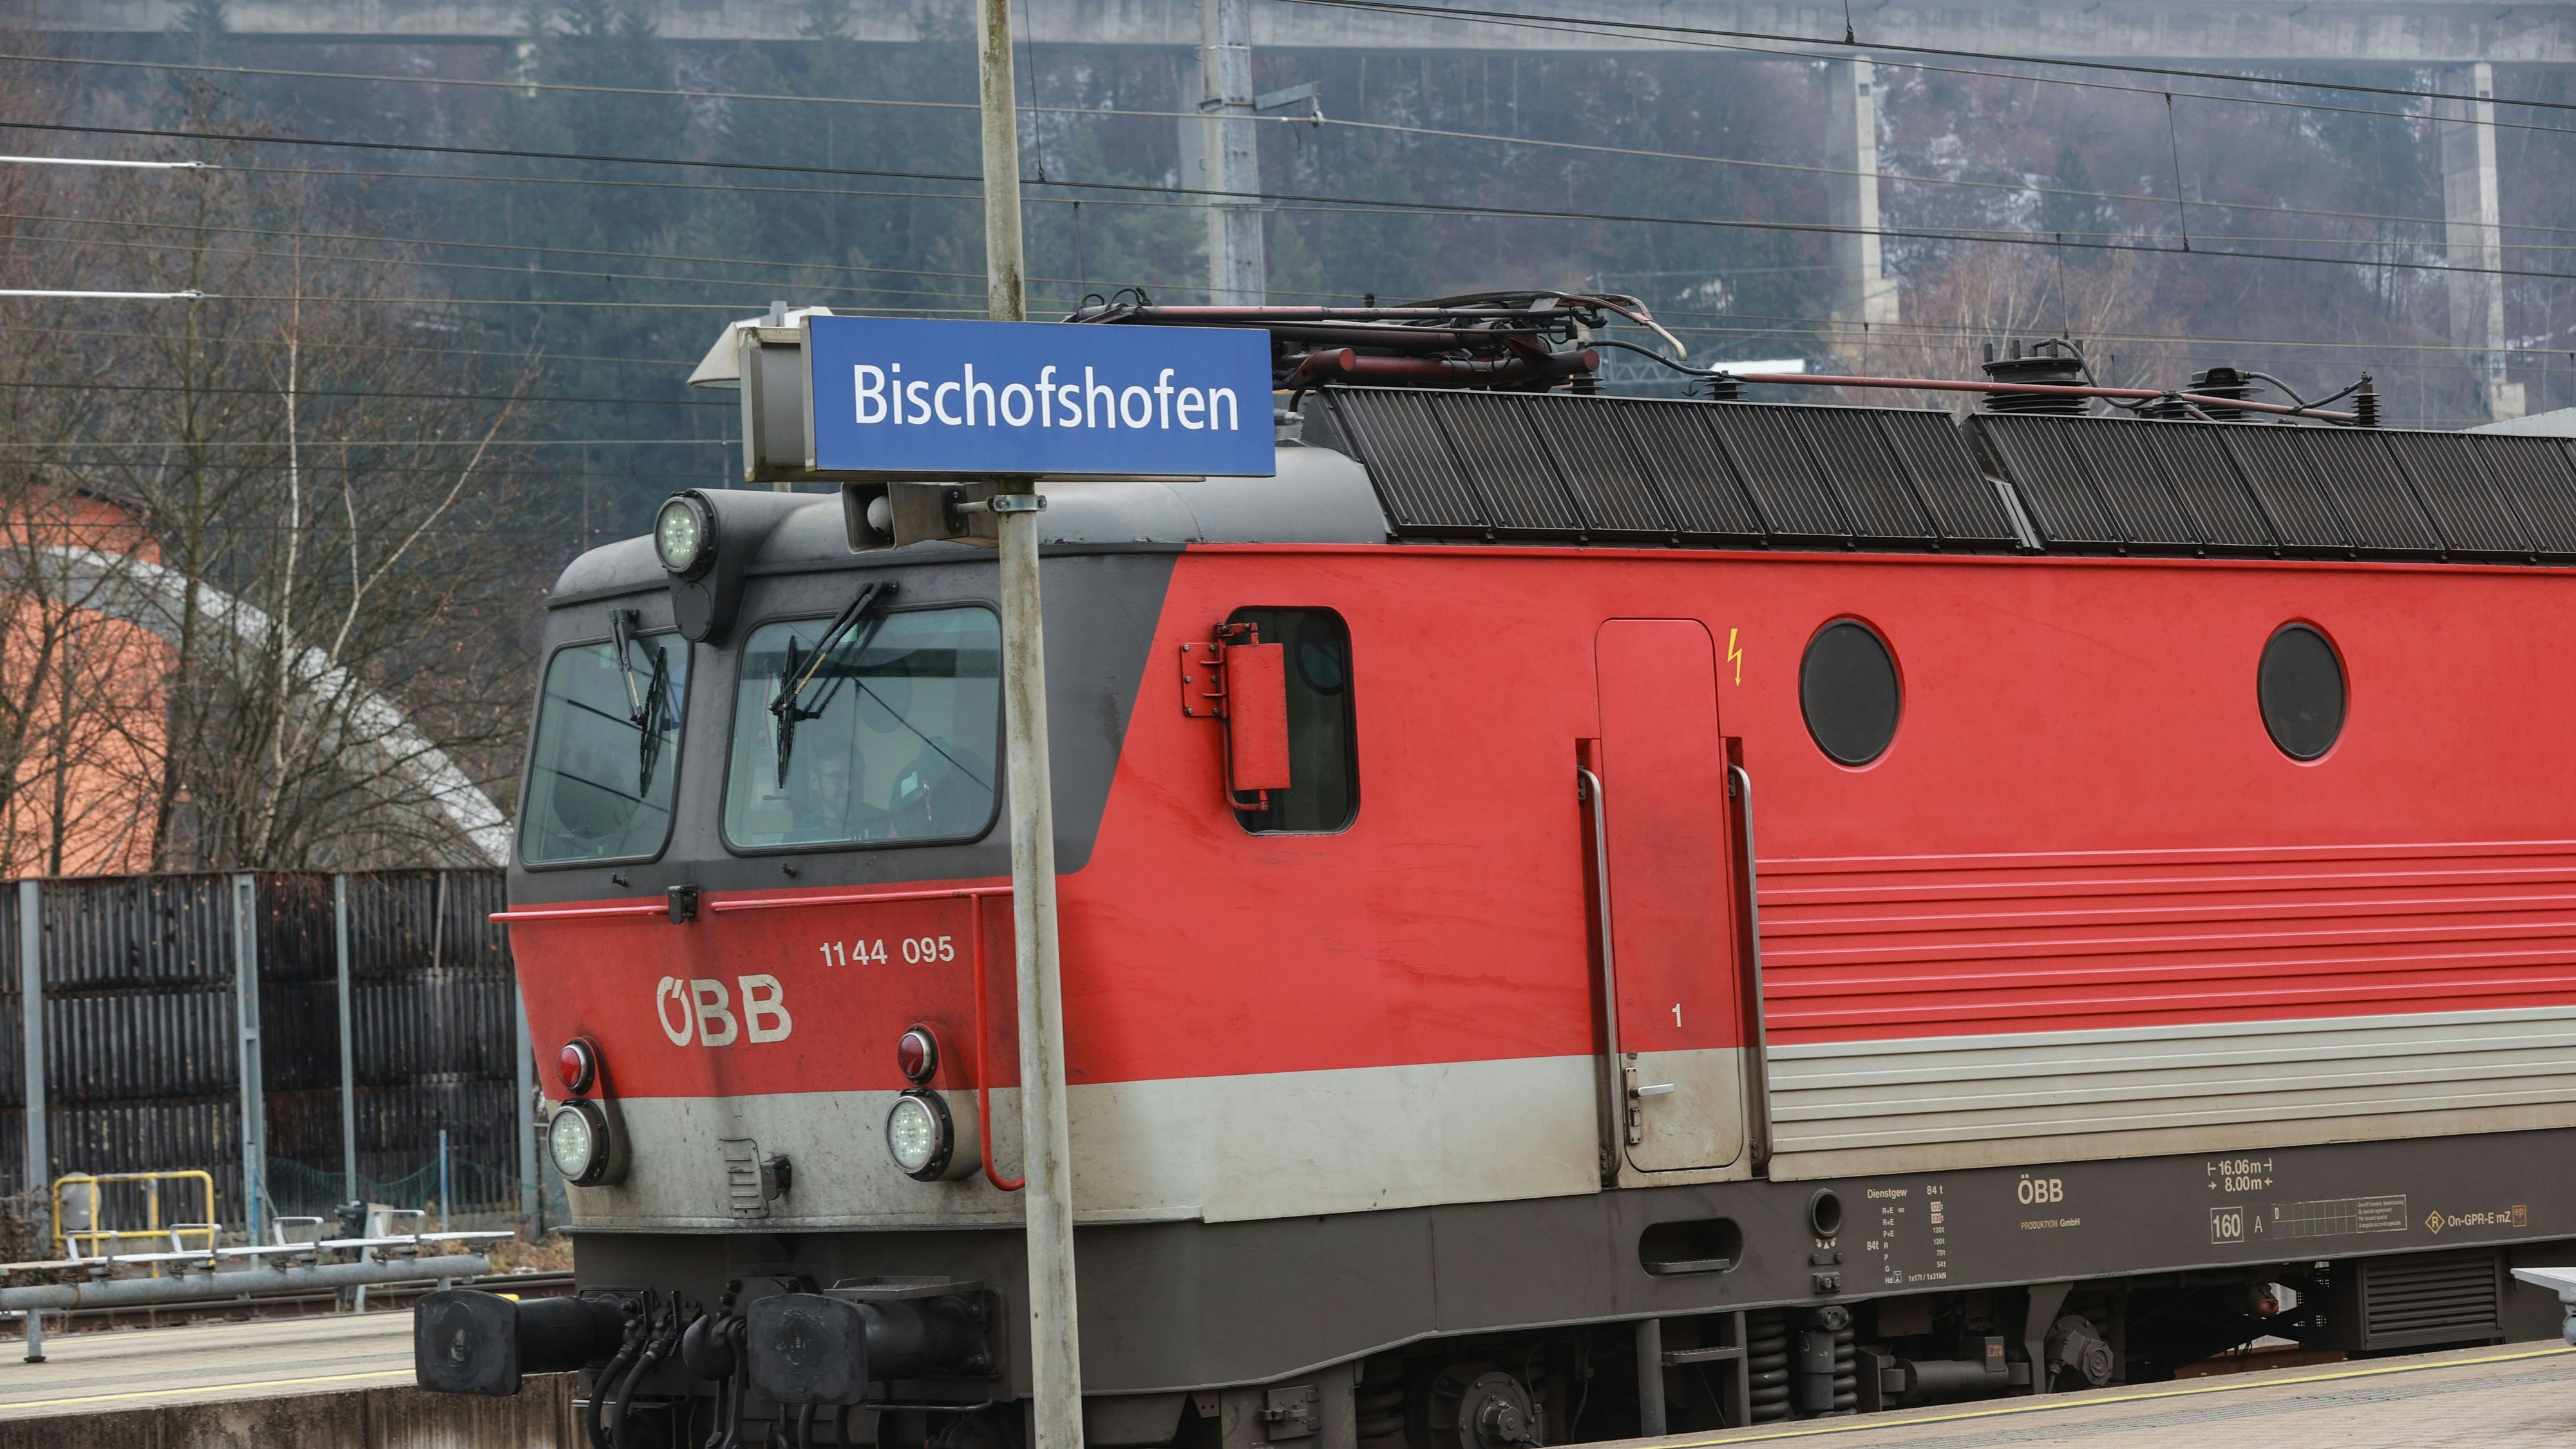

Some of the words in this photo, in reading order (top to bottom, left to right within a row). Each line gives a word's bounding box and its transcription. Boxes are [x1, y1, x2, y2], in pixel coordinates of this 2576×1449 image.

[853, 363, 1238, 430] Bischofshofen
[819, 939, 888, 967] 1144
[902, 936, 955, 964] 095
[656, 974, 793, 1047] ÖBB
[1672, 1003, 1681, 1027] 1
[2219, 1159, 2261, 1175] 16.06m
[2018, 1173, 2063, 1205] ÖBB
[2225, 1175, 2262, 1192] 8.00m
[1867, 1188, 1907, 1199] Dienstgew
[1926, 1186, 1937, 1195] 84
[2275, 1207, 2280, 1220] D
[2448, 1212, 2494, 1227] On-GPR-E
[2021, 1220, 2058, 1230] PRODUKTION
[2060, 1218, 2080, 1227] GmbH
[2213, 1213, 2241, 1238] 160
[2254, 1215, 2263, 1233] A
[2432, 1216, 2439, 1228] R
[1867, 1240, 1879, 1251] 84t
